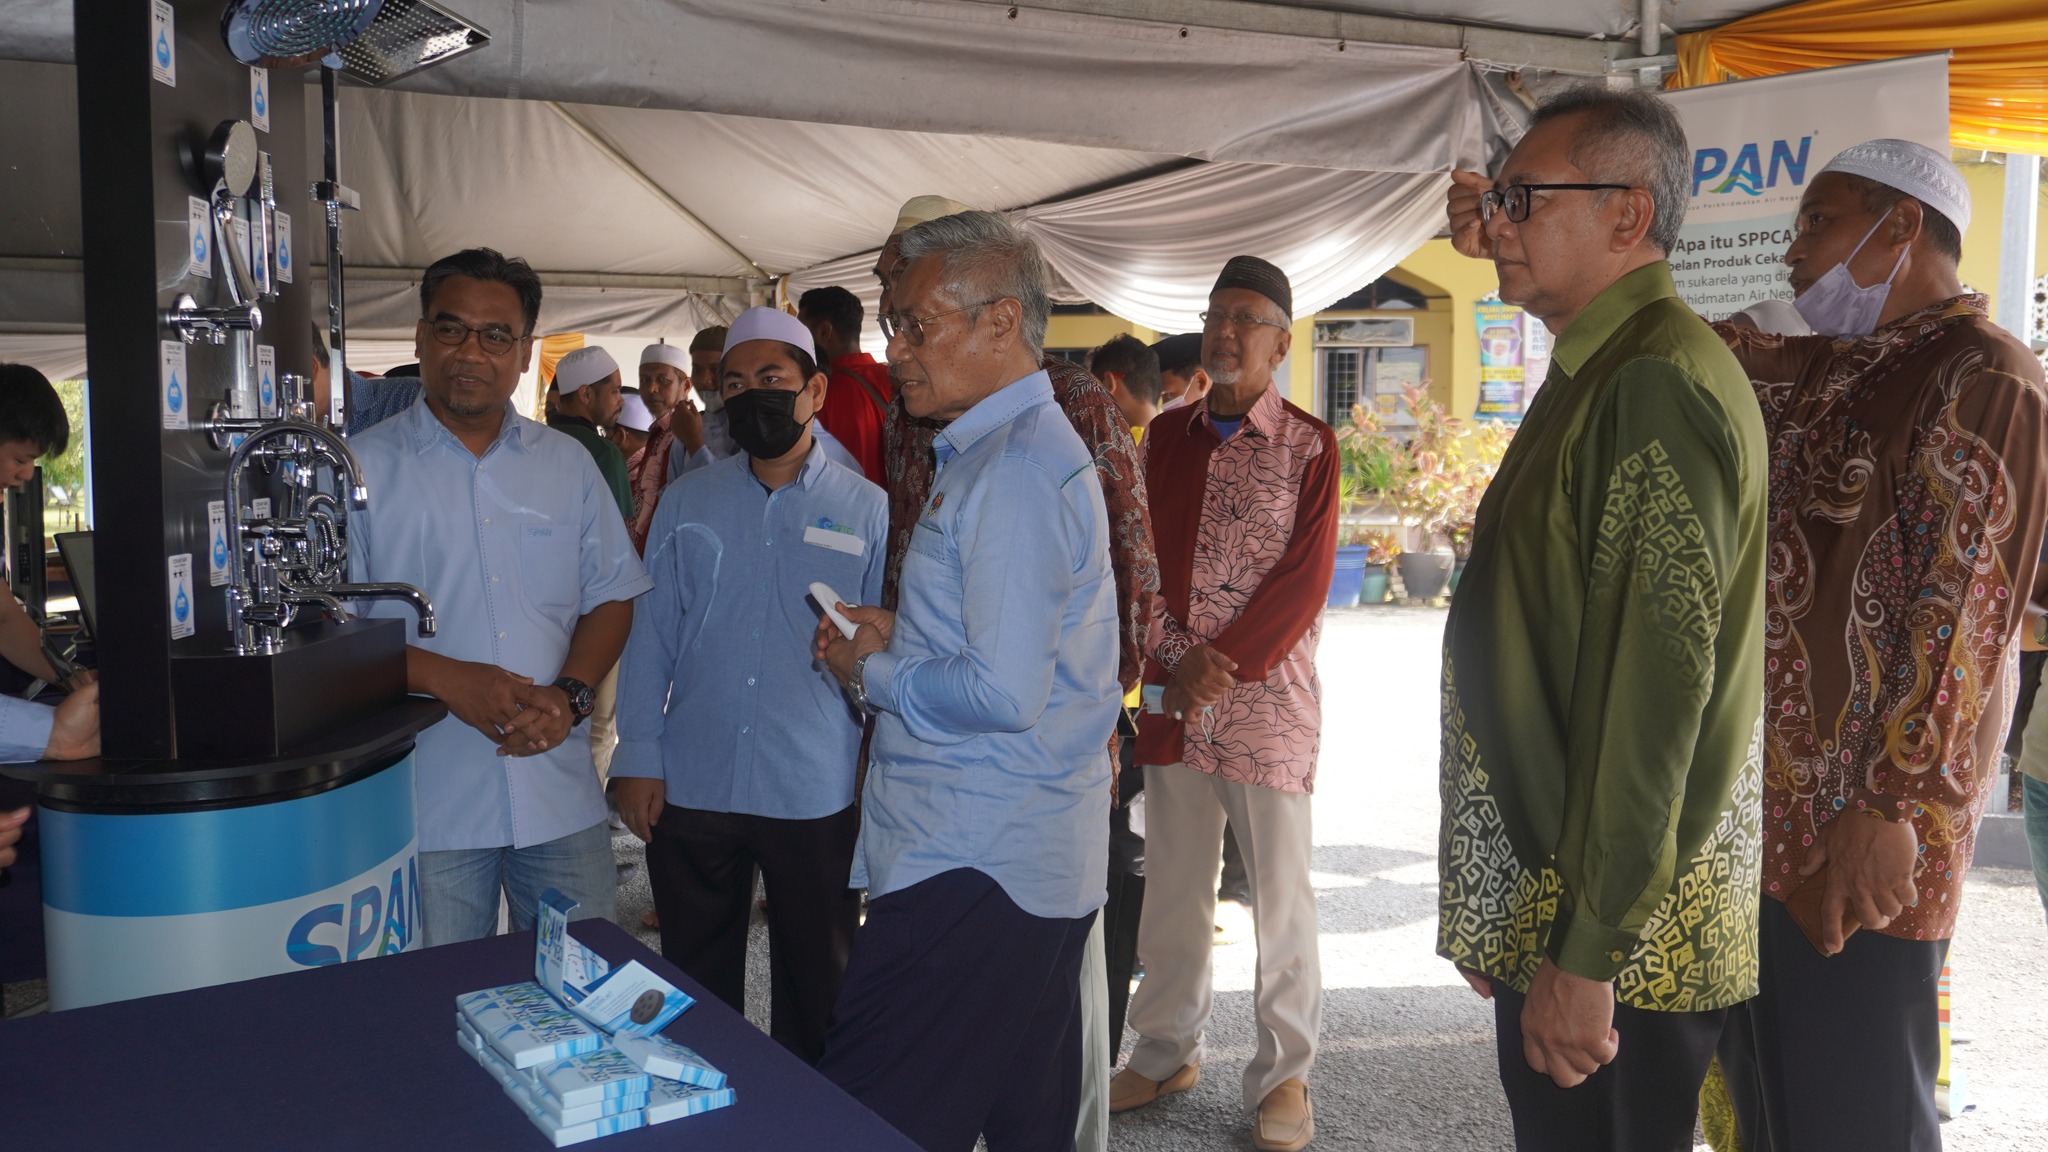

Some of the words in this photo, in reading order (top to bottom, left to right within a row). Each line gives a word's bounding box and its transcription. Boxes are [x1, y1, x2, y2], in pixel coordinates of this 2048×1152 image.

[1692, 136, 1812, 196] PAN
[1676, 239, 1706, 255] Apa
[1711, 235, 1733, 250] itu
[1738, 229, 1796, 248] SPPCA
[1704, 255, 1752, 269] Produk
[1755, 252, 1785, 265] Ceka
[1688, 273, 1738, 288] sukarela
[1741, 273, 1772, 287] yang
[1775, 269, 1792, 284] dip
[1749, 289, 1766, 302] Air
[1770, 288, 1794, 302] Neg
[286, 855, 422, 967] SPAN
